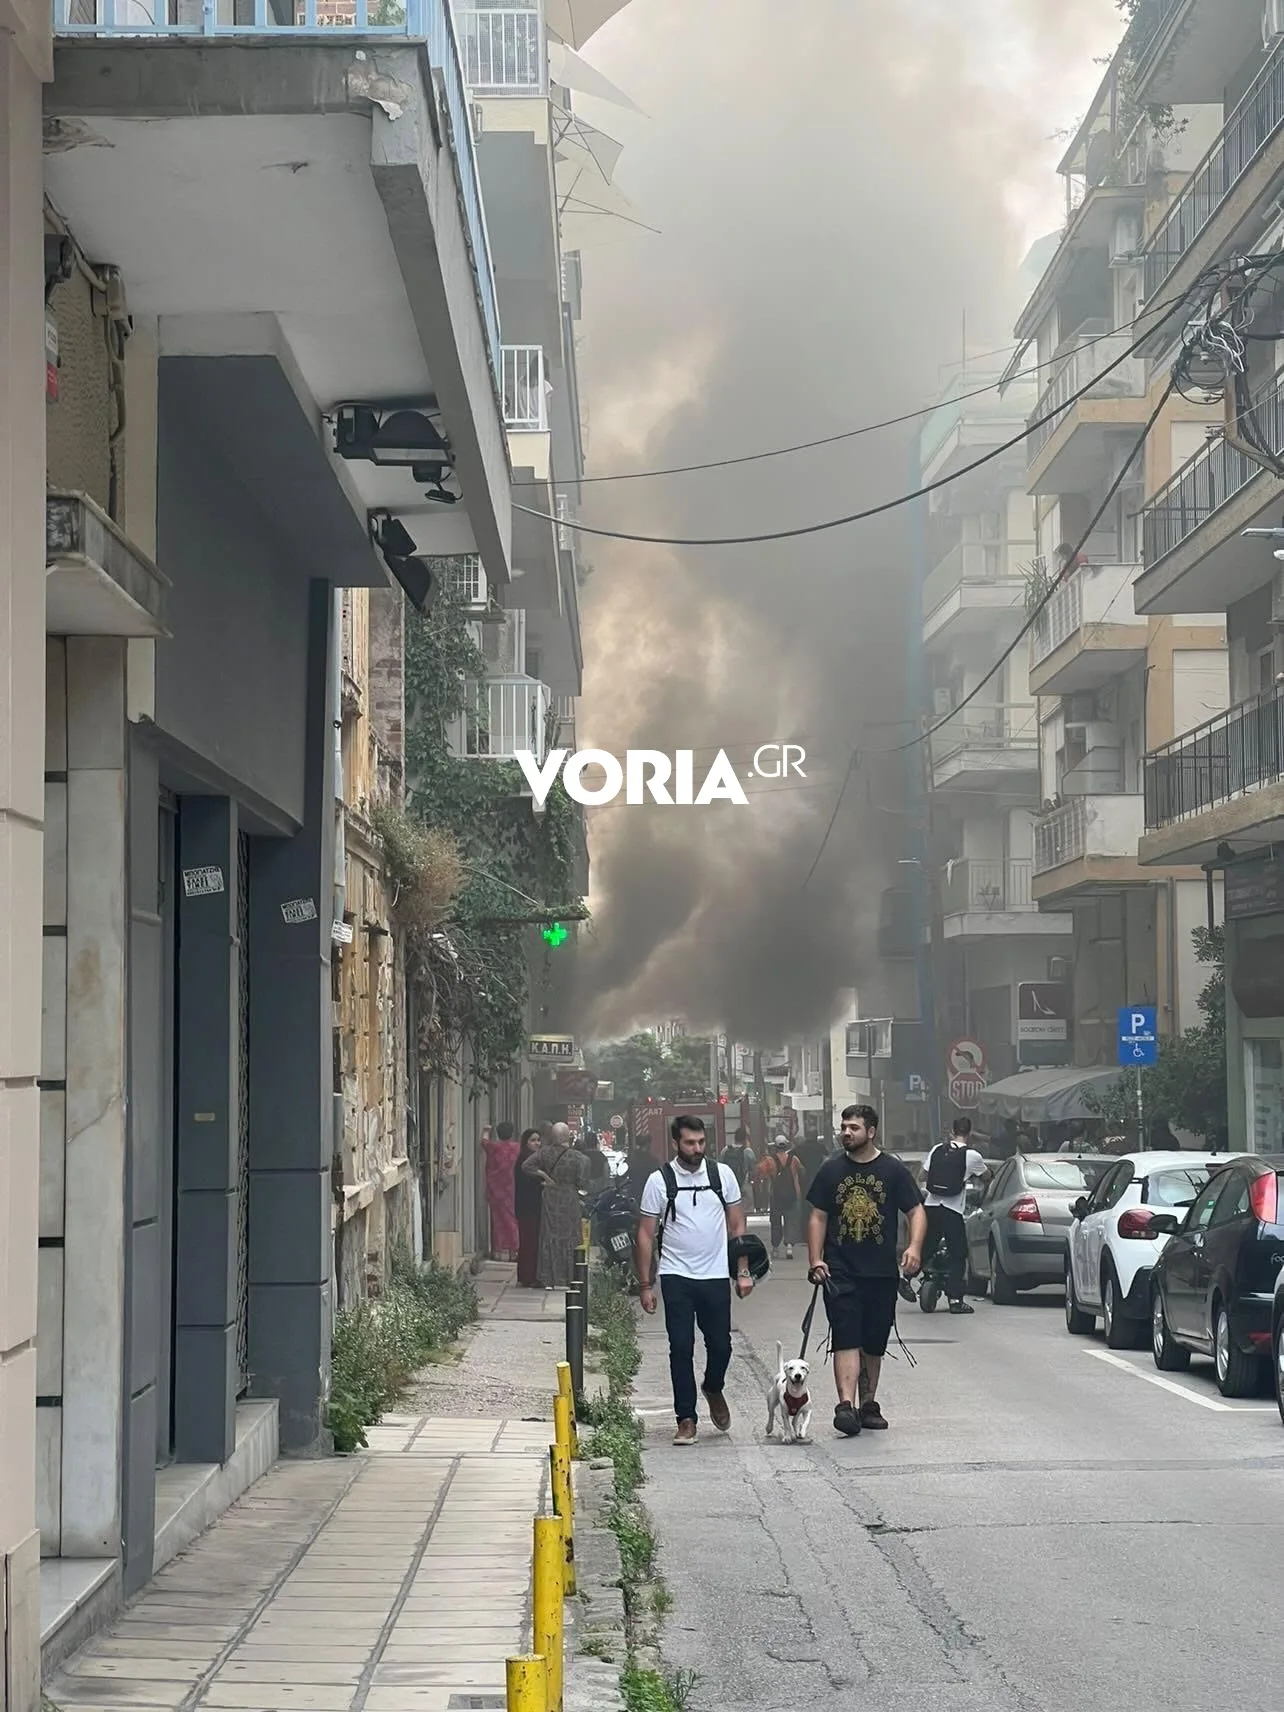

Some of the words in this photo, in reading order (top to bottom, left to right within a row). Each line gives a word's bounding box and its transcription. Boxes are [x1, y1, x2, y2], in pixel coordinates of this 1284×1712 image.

[1131, 1013, 1145, 1034] P
[531, 1042, 572, 1056] Κ.Α.Π.Η.
[908, 1074, 921, 1091] P
[951, 1080, 983, 1099] STOP
